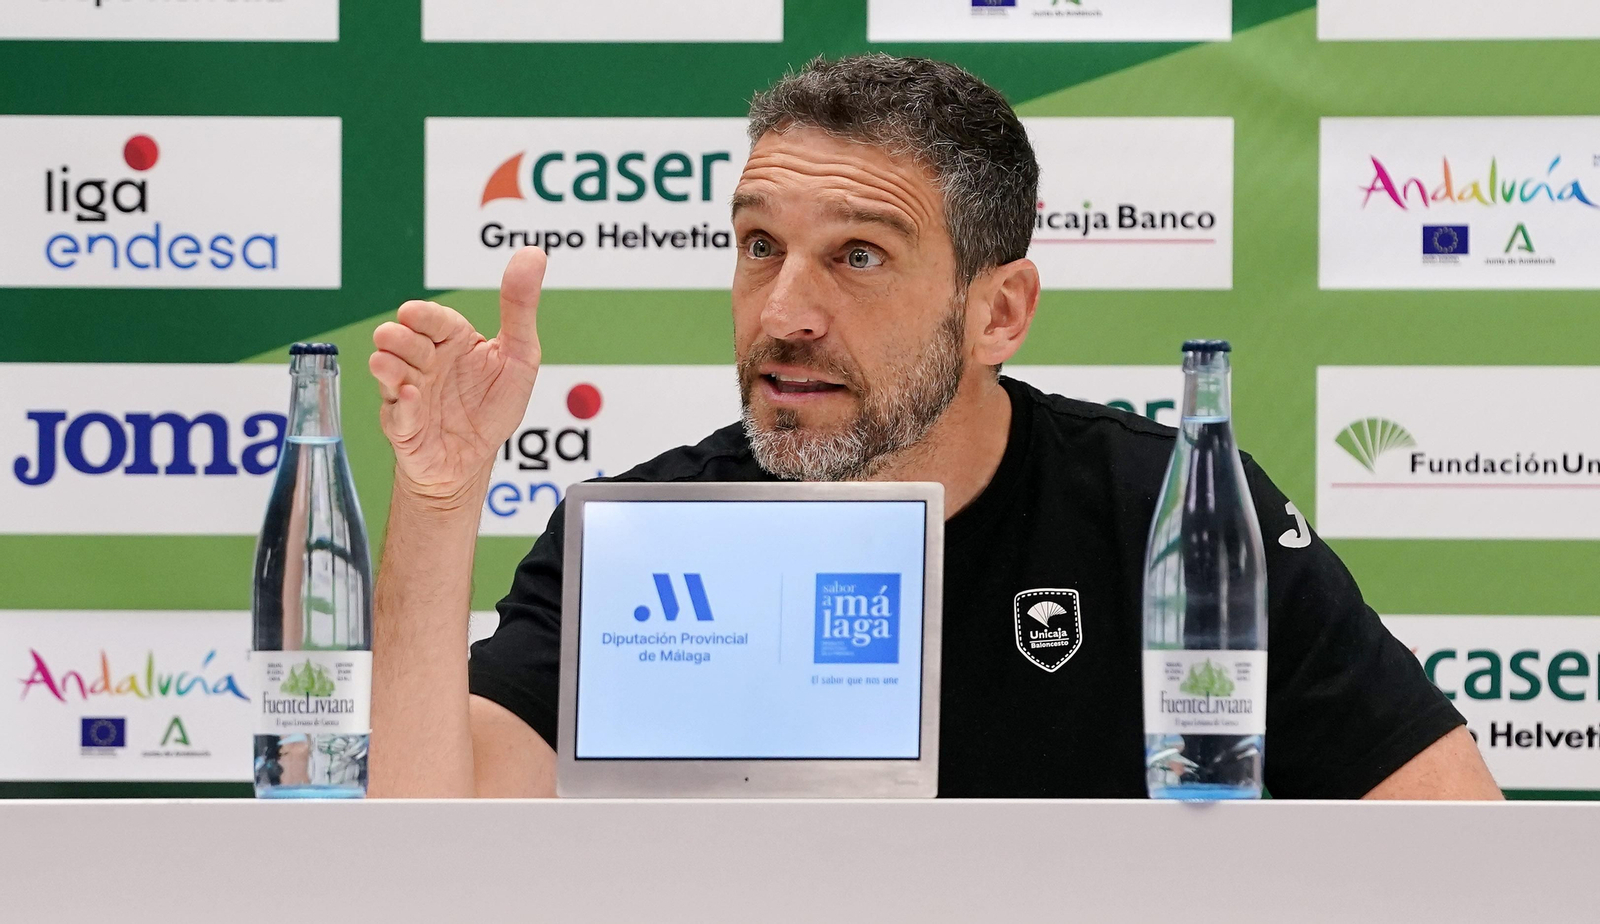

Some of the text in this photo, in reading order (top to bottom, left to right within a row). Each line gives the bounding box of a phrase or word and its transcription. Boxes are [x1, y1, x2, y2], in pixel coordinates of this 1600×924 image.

[531, 150, 731, 202] caser
[1358, 153, 1600, 212] Andalucía
[46, 165, 147, 222] liga
[1036, 201, 1216, 237] icaja Banco
[46, 221, 279, 269] endesa
[480, 222, 731, 255] Grupo Helvetia
[822, 594, 832, 606] a
[823, 580, 857, 594] sabor
[601, 631, 749, 647] Diputación Provincial
[1029, 626, 1068, 640] Unicaja
[1030, 640, 1069, 649] Baloncesto
[638, 648, 712, 665] de Málaga
[17, 648, 252, 705] Andalucía
[847, 676, 863, 687] que
[1424, 649, 1600, 701] case
[263, 690, 355, 715] FuenteLiviana
[1160, 689, 1253, 714] FuenteLiviana
[1490, 720, 1600, 749] Helvet
